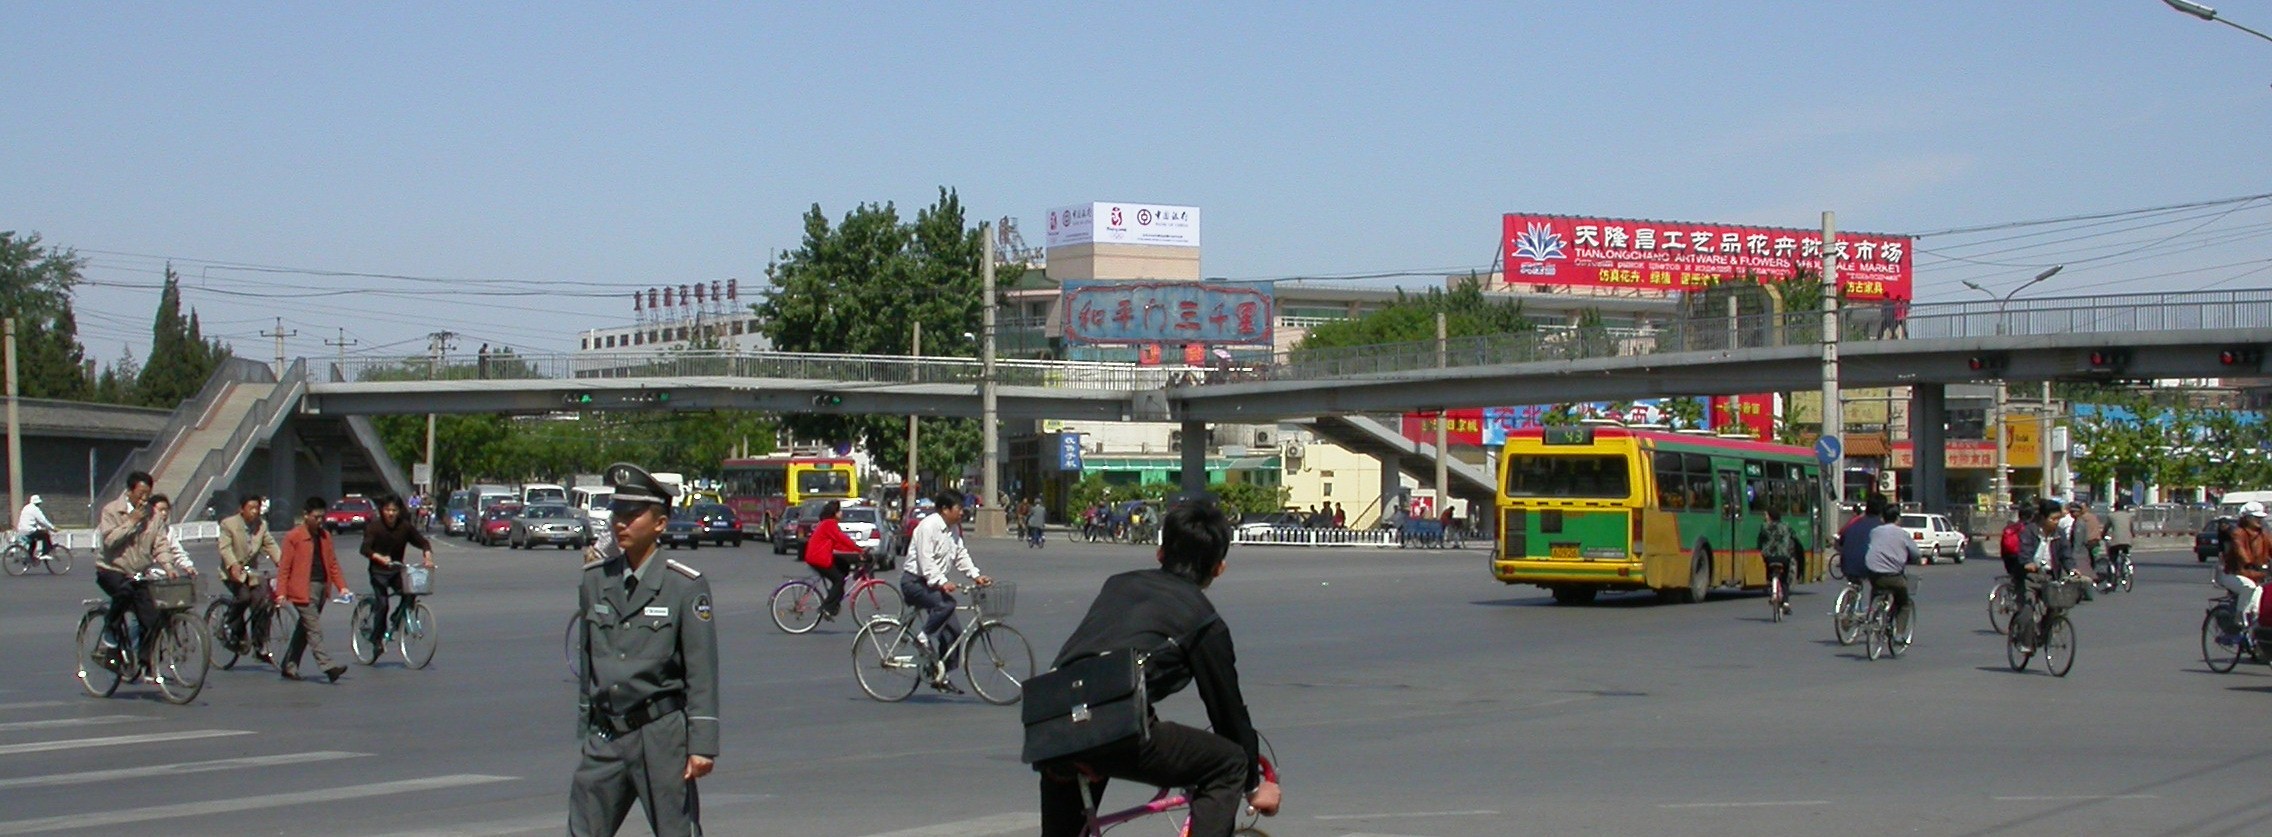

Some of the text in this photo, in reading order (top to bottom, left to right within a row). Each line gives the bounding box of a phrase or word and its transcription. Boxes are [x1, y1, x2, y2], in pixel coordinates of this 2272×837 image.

[1575, 248, 1670, 263] TIANLONGCHANG
[1675, 253, 1728, 265] ARTWARE
[1730, 257, 1737, 265] &
[1740, 257, 1791, 268] FLOWERS
[1859, 262, 1901, 274] MARKET
[1078, 298, 1258, 335] 和平门三千里
[1564, 430, 1584, 444] 43
